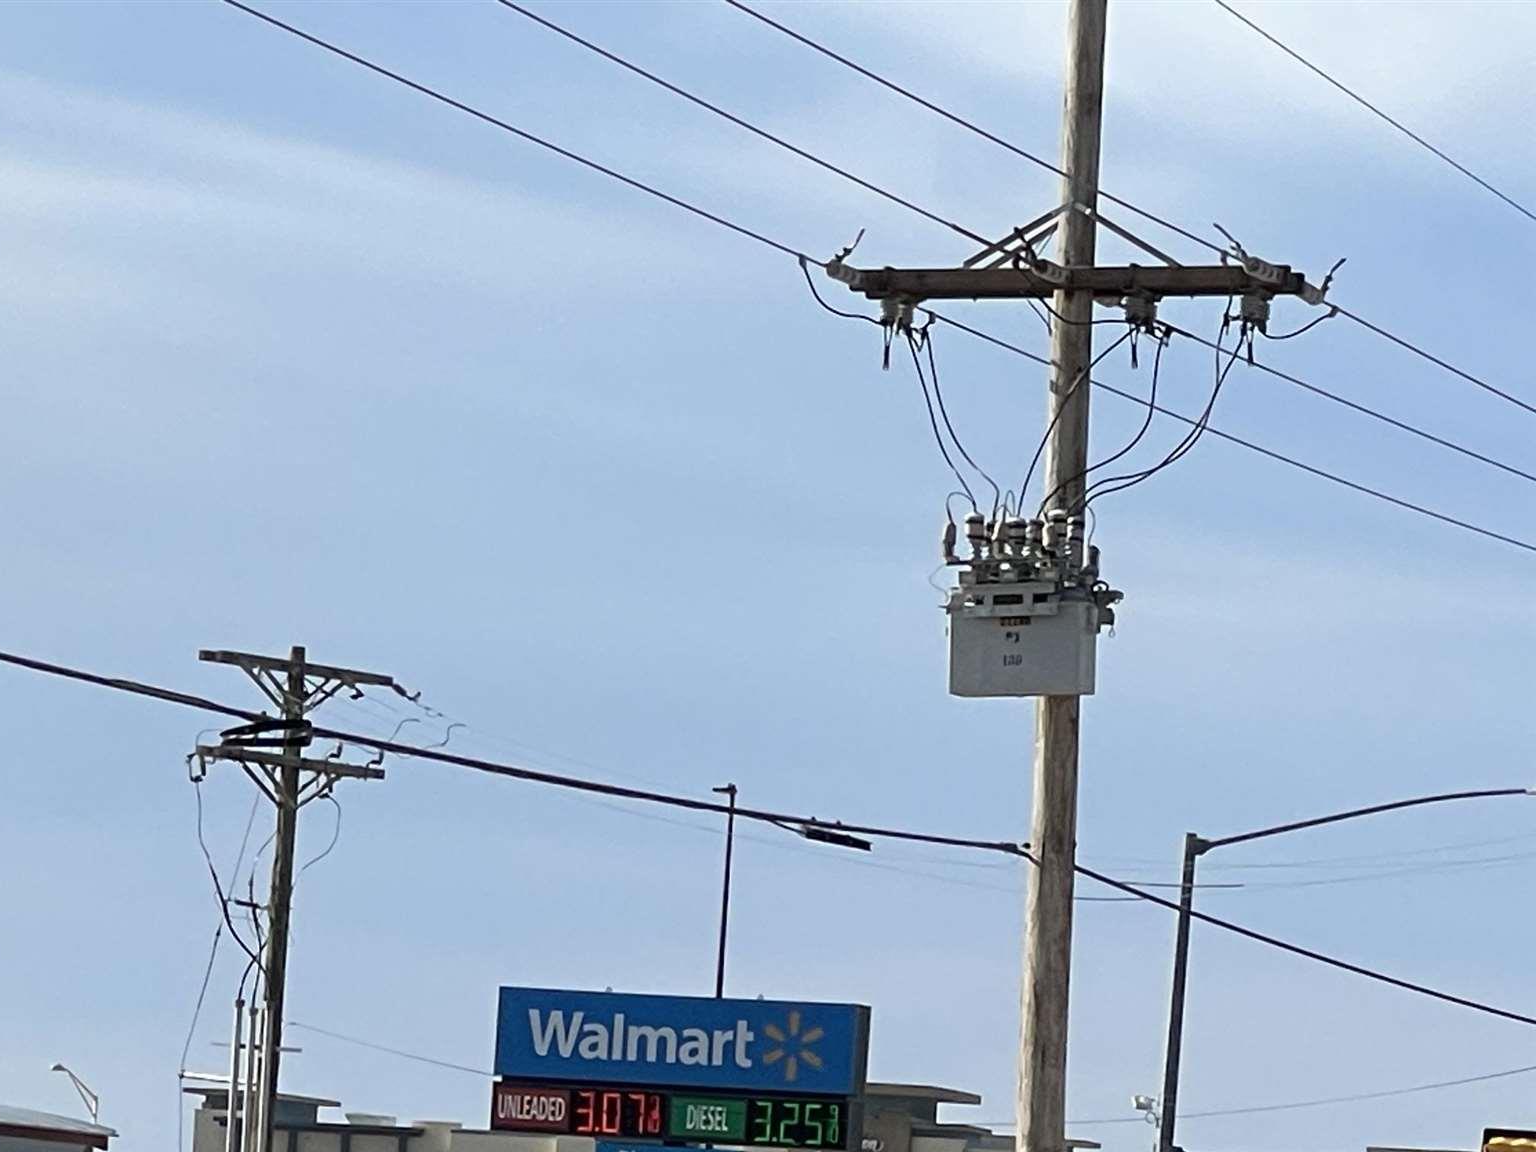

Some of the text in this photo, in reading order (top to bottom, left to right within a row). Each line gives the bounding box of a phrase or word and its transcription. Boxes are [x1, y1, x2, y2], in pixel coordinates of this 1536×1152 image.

[528, 1009, 754, 1068] Walmart
[497, 1093, 566, 1121] UNLEADED
[686, 1104, 729, 1132] DIESEL
